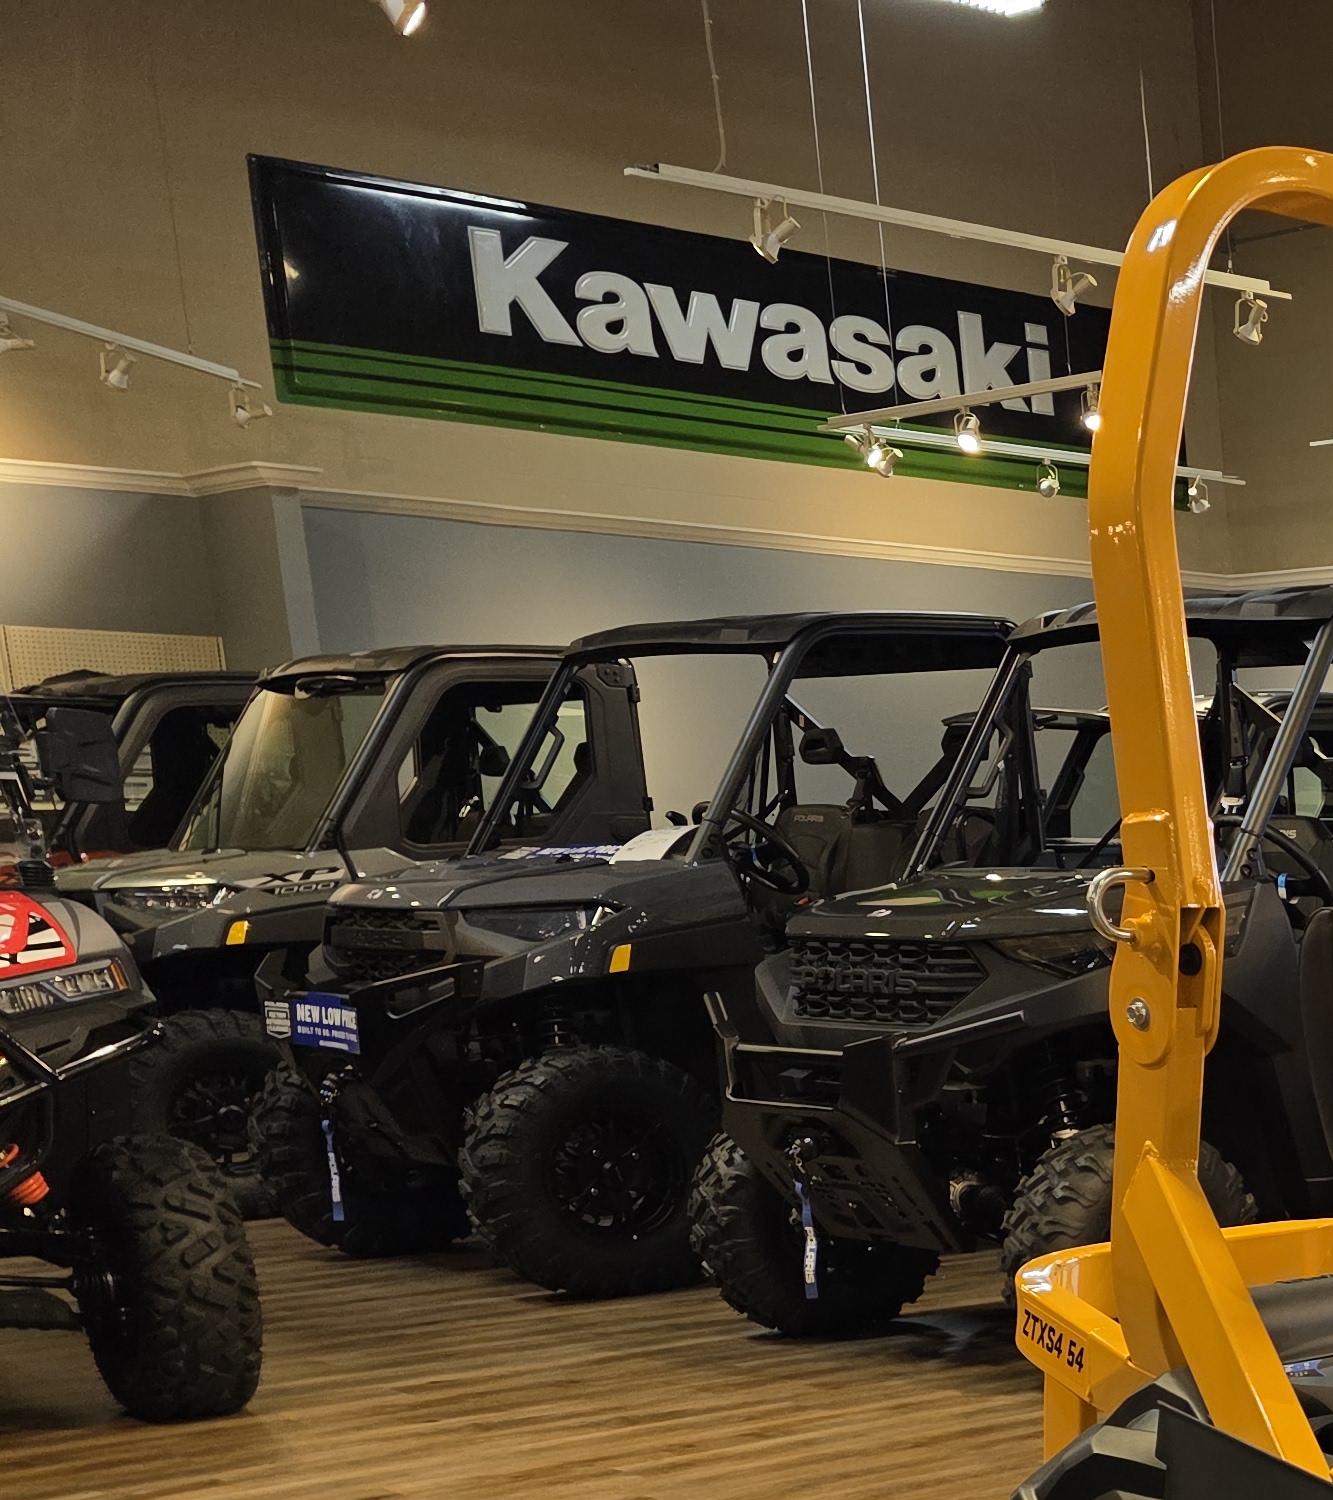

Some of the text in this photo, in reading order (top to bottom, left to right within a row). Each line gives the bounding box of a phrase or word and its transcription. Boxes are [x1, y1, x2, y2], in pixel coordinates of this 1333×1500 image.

[467, 226, 1055, 417] Kawasaki
[256, 866, 341, 887] XP
[273, 881, 336, 895] 1000
[797, 965, 918, 995] POLARIS
[296, 1003, 321, 1024] NEW
[322, 1006, 341, 1026] LOW
[804, 1226, 817, 1284] POLARIS
[1022, 1307, 1085, 1375] ZTXS4 54
